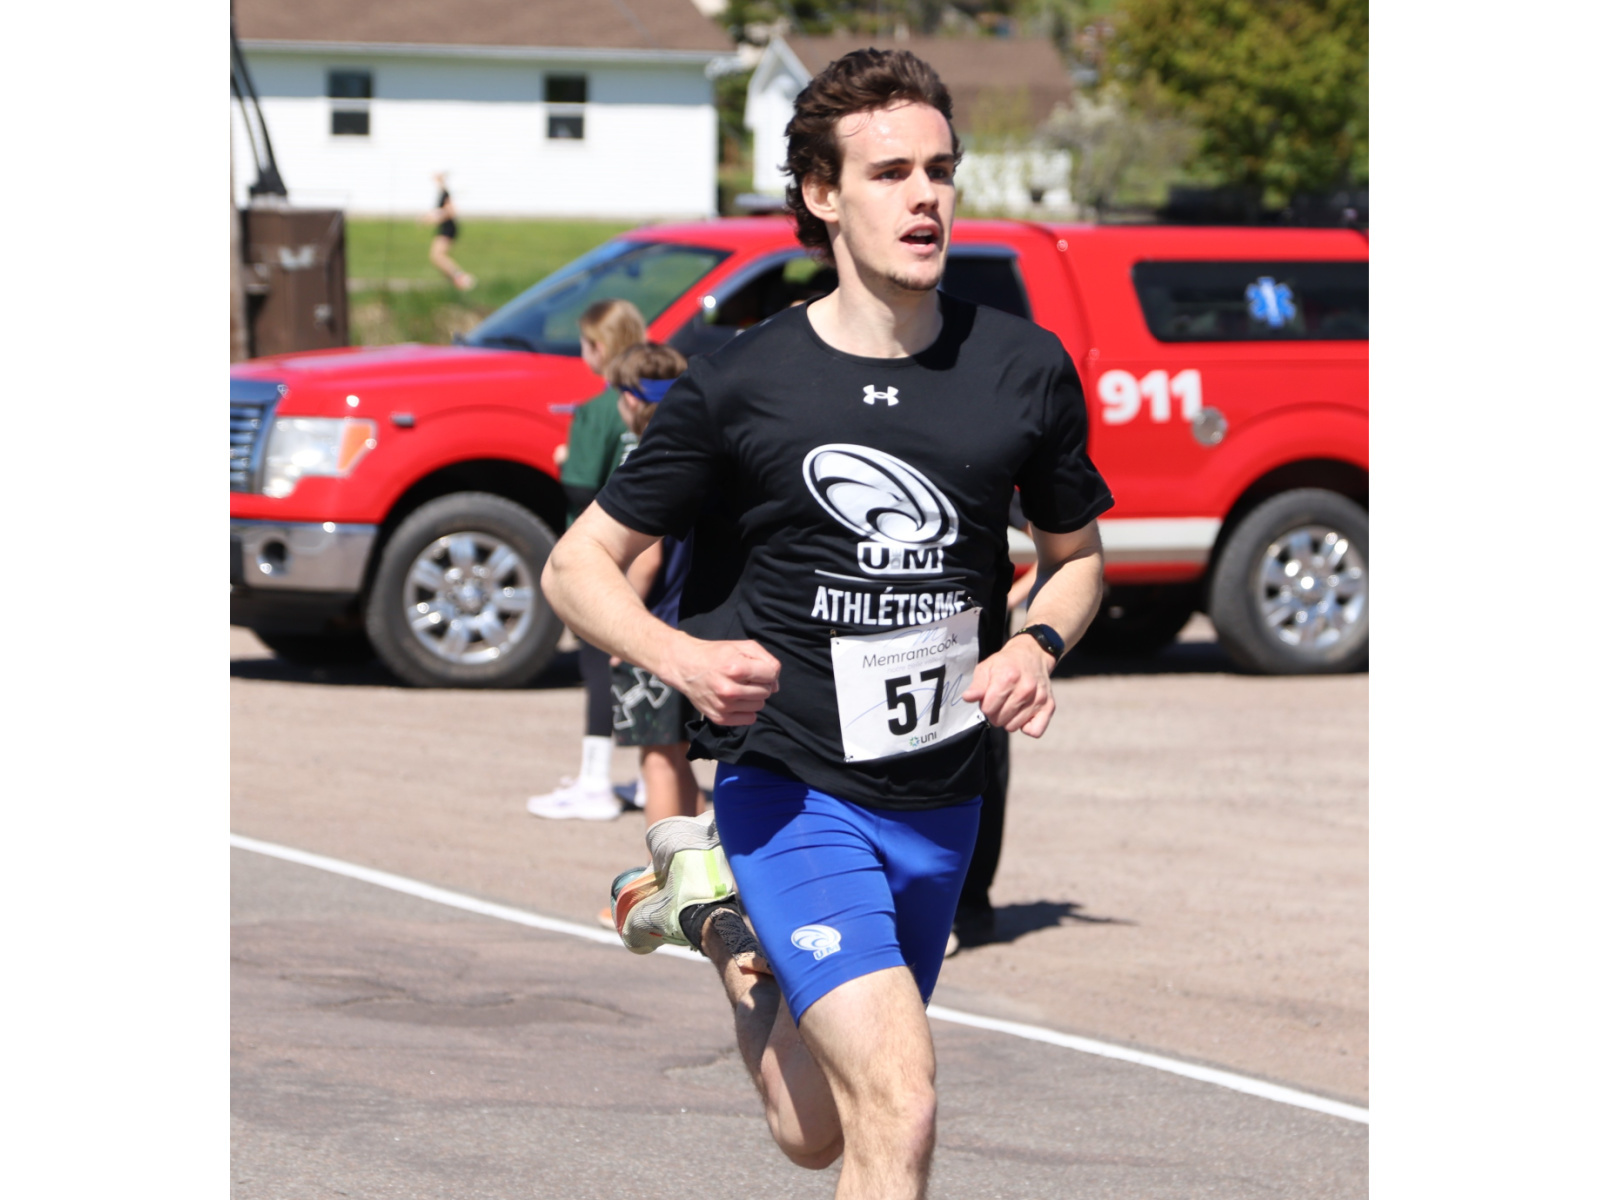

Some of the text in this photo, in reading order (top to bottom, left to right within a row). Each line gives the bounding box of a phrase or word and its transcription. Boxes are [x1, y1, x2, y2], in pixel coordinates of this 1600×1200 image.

[1097, 369, 1203, 425] 911
[811, 586, 966, 626] ATHLÉTISME
[862, 634, 958, 669] Memramcook
[885, 664, 946, 736] 57
